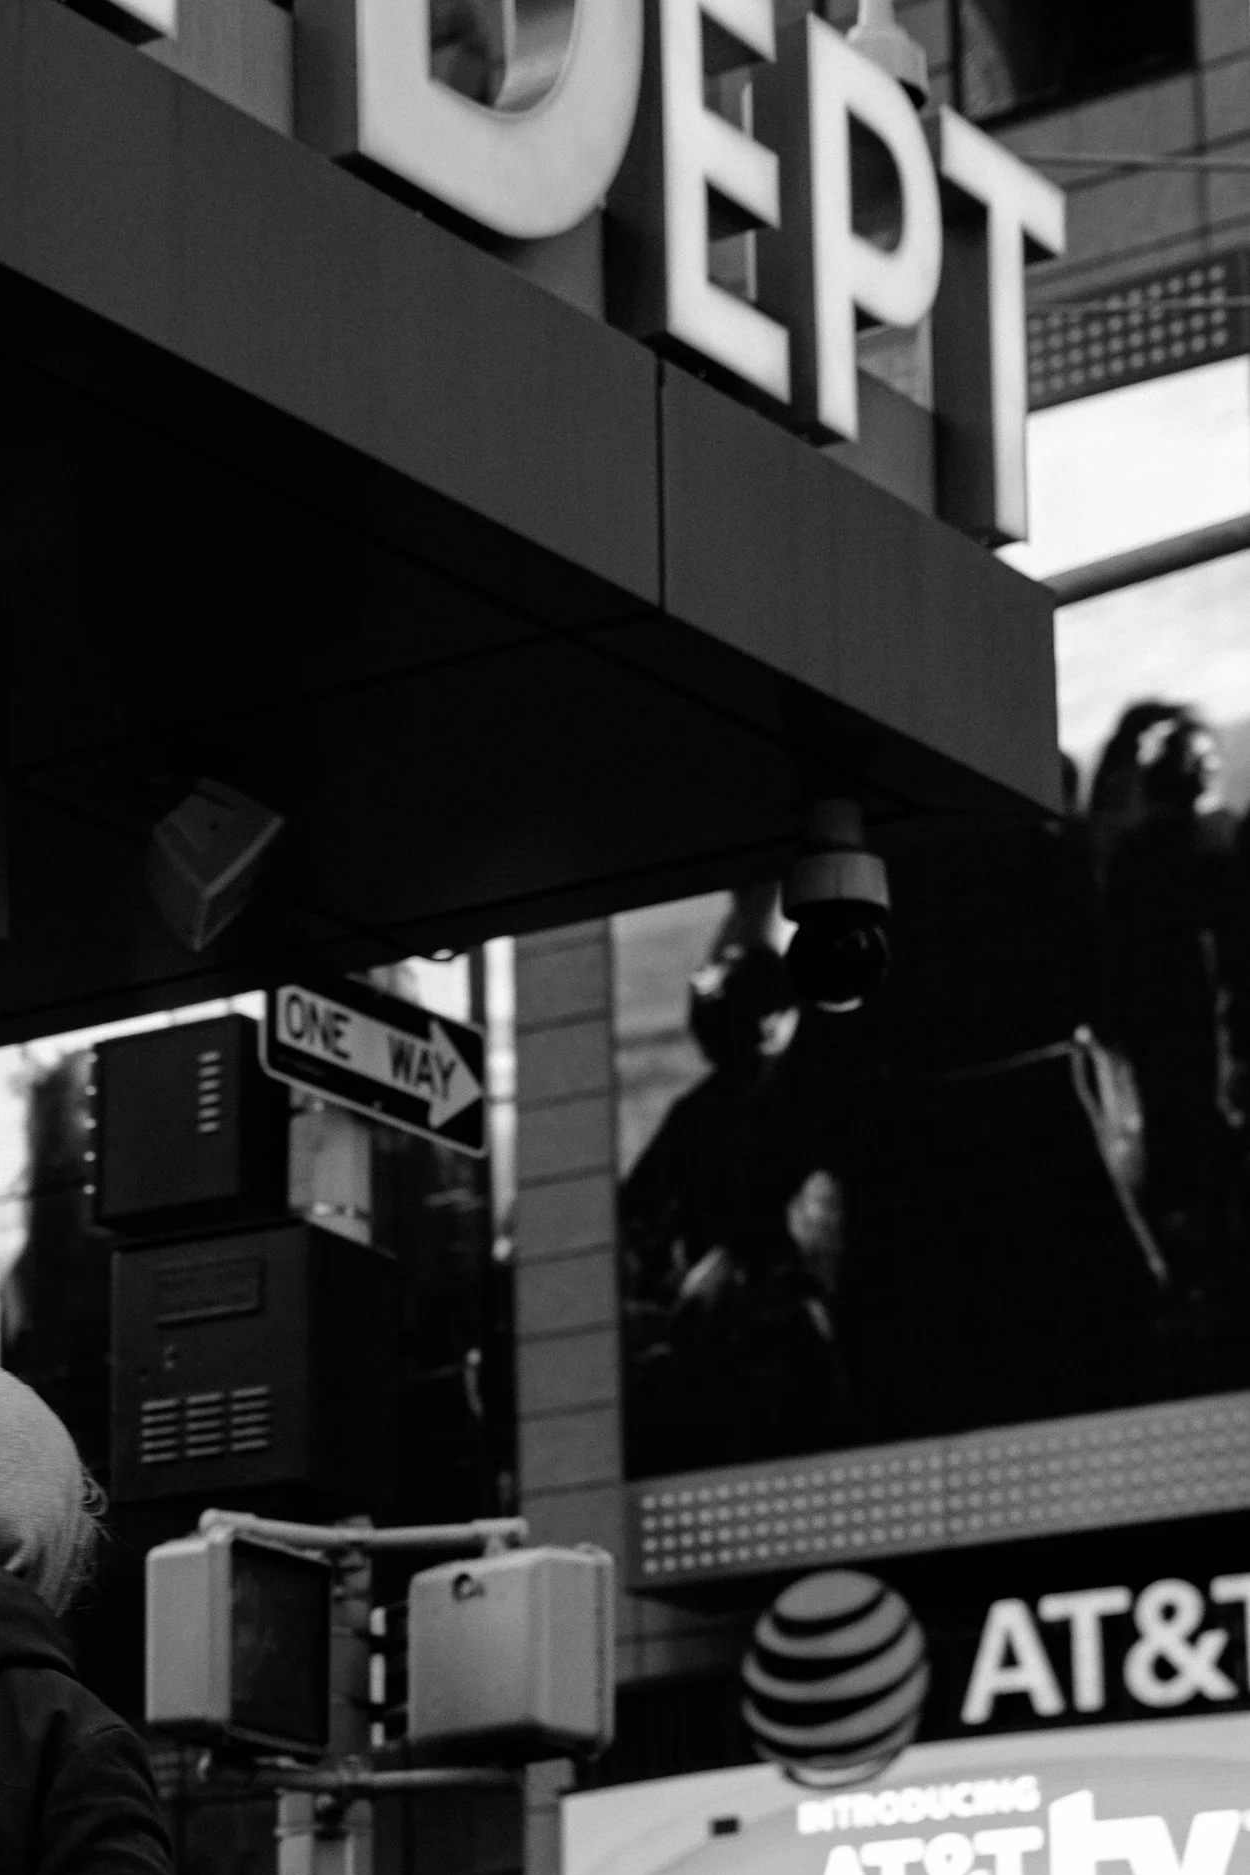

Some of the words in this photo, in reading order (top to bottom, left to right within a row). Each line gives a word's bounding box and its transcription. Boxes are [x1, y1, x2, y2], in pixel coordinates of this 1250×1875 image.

[285, 993, 352, 1062] ONE
[387, 1031, 458, 1104] WAY
[797, 1775, 1042, 1835] INTRODUCING
